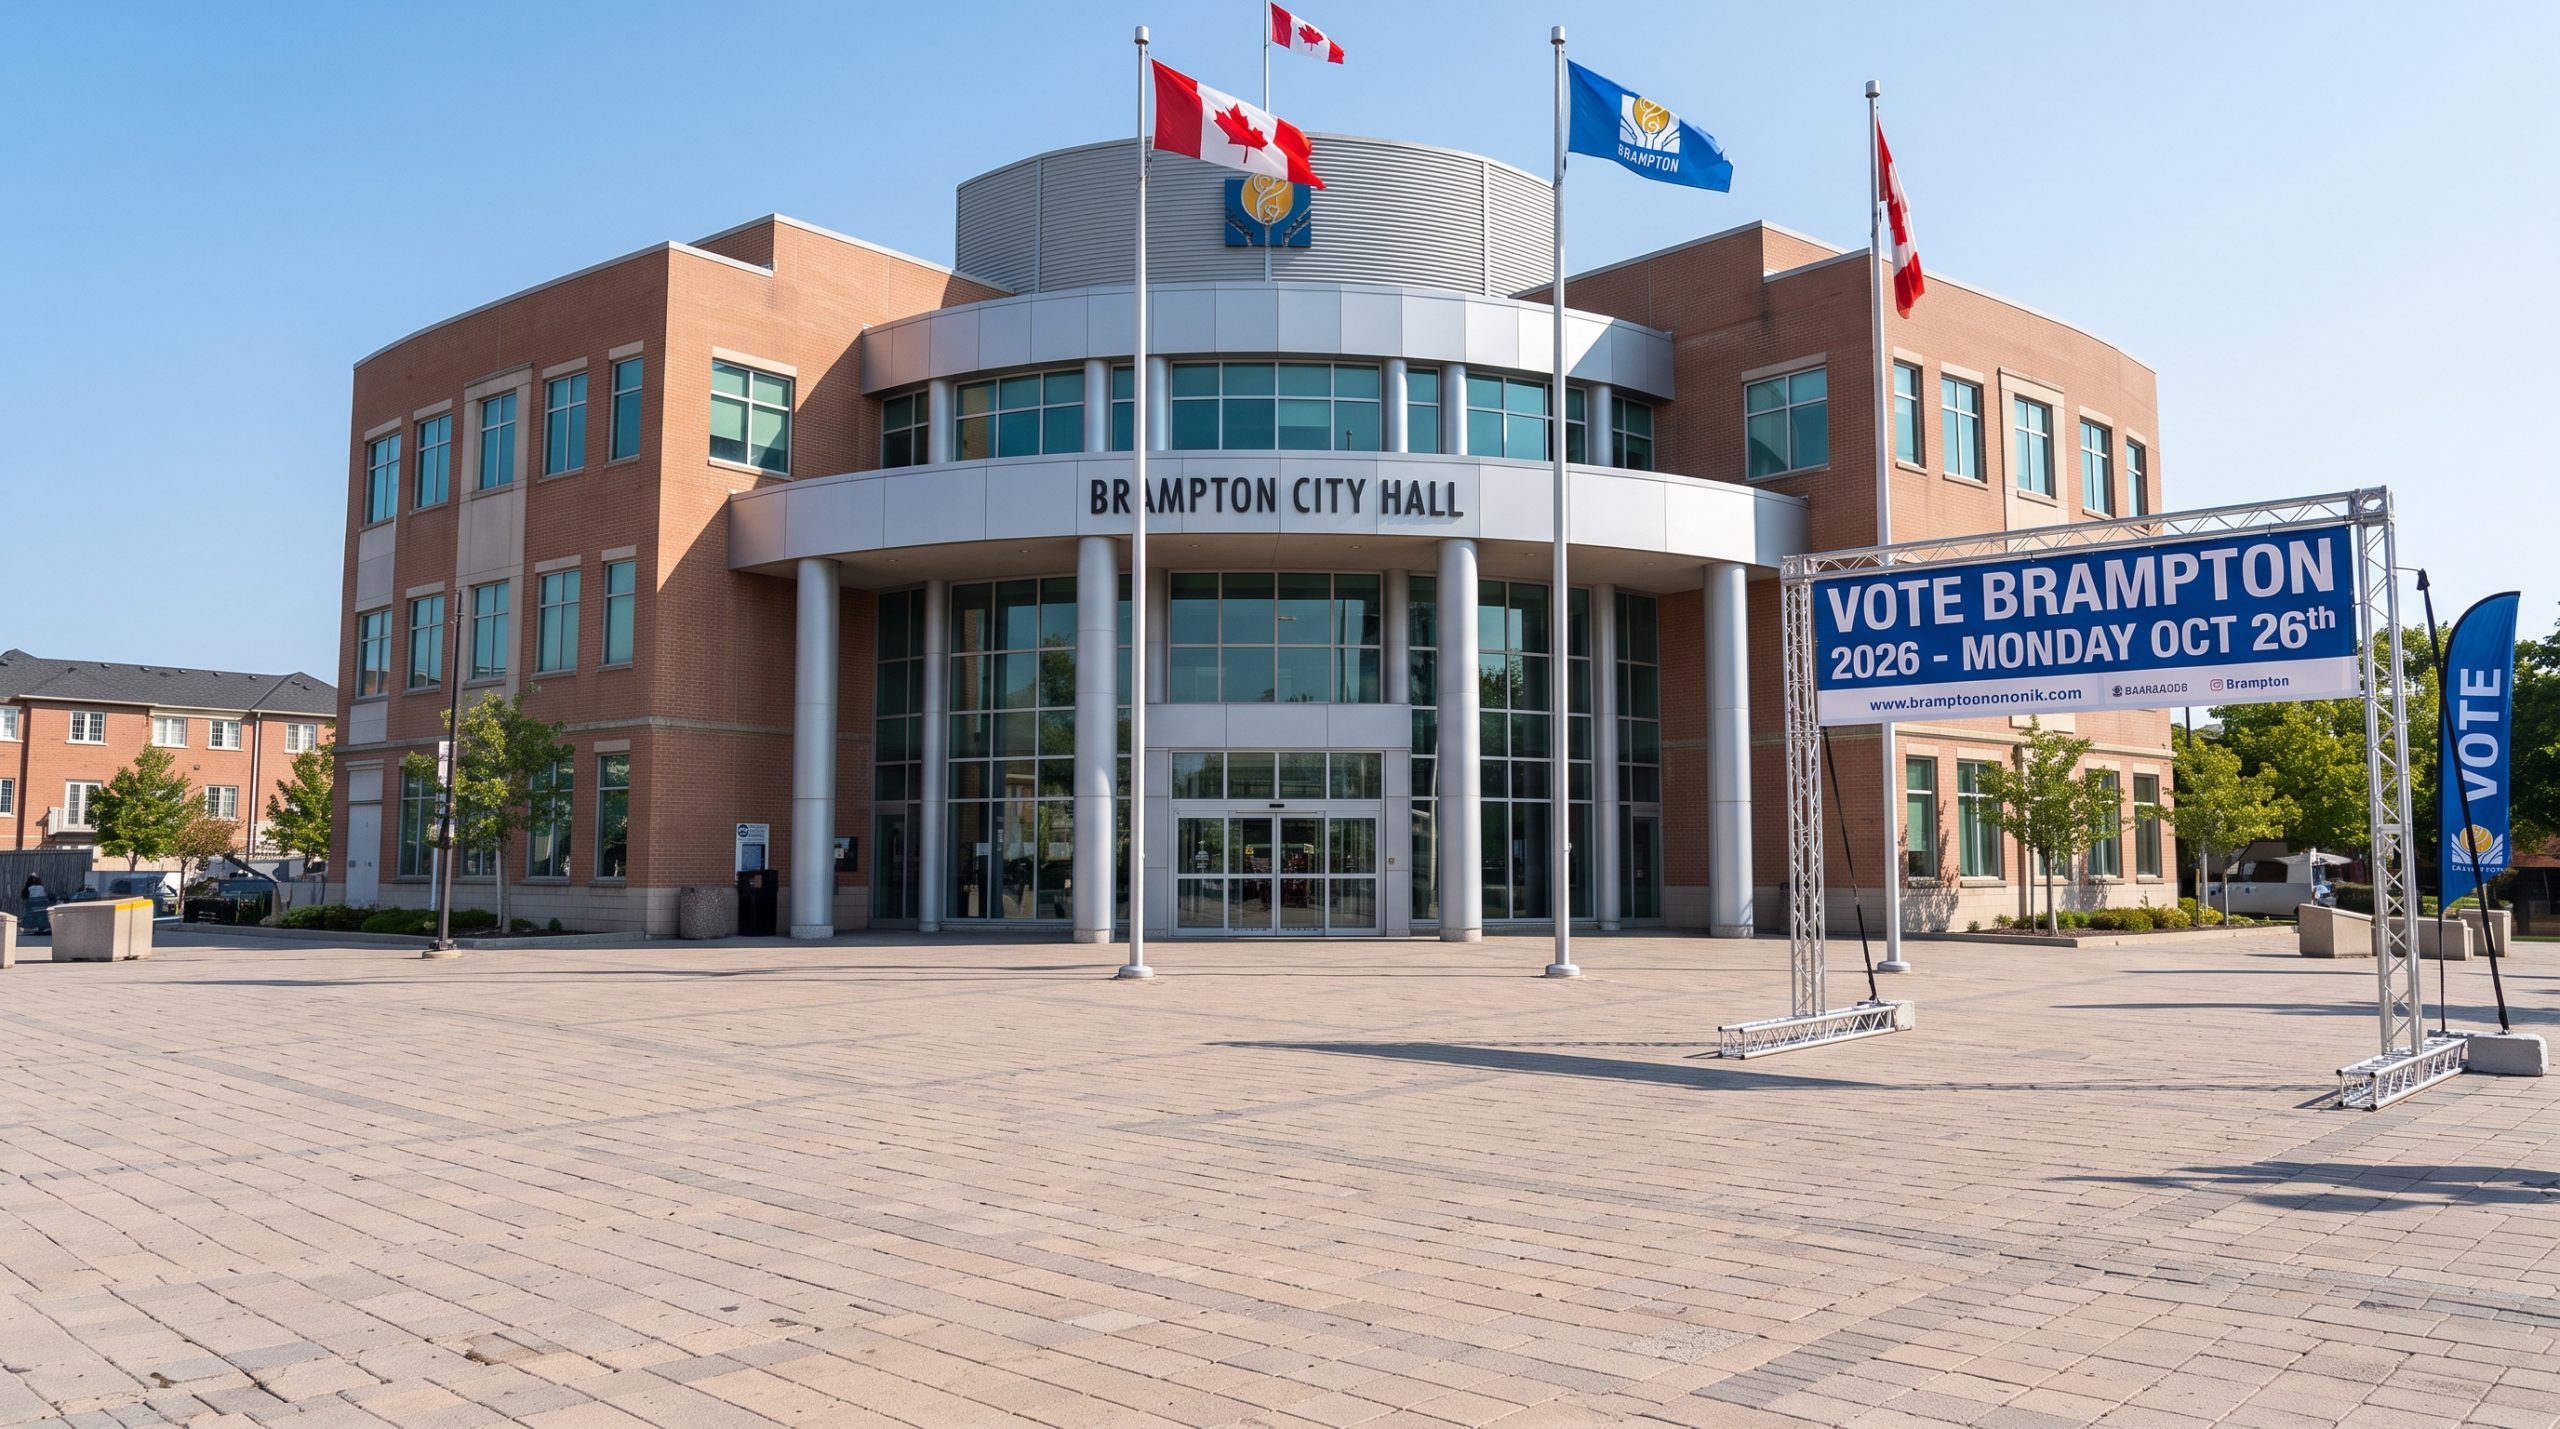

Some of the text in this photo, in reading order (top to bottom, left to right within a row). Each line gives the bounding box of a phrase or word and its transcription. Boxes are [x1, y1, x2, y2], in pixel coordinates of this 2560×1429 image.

[1618, 144, 1680, 173] BRAMPTON
[1090, 477, 1464, 517] BRAMPTON CITY HALL
[1827, 537, 2335, 633] VOTE BRAMPTON
[1830, 606, 2337, 680] 2026 - MONDAY OCT 26th
[2226, 676, 2289, 690] Brampton
[2457, 668, 2502, 802] VOTE
